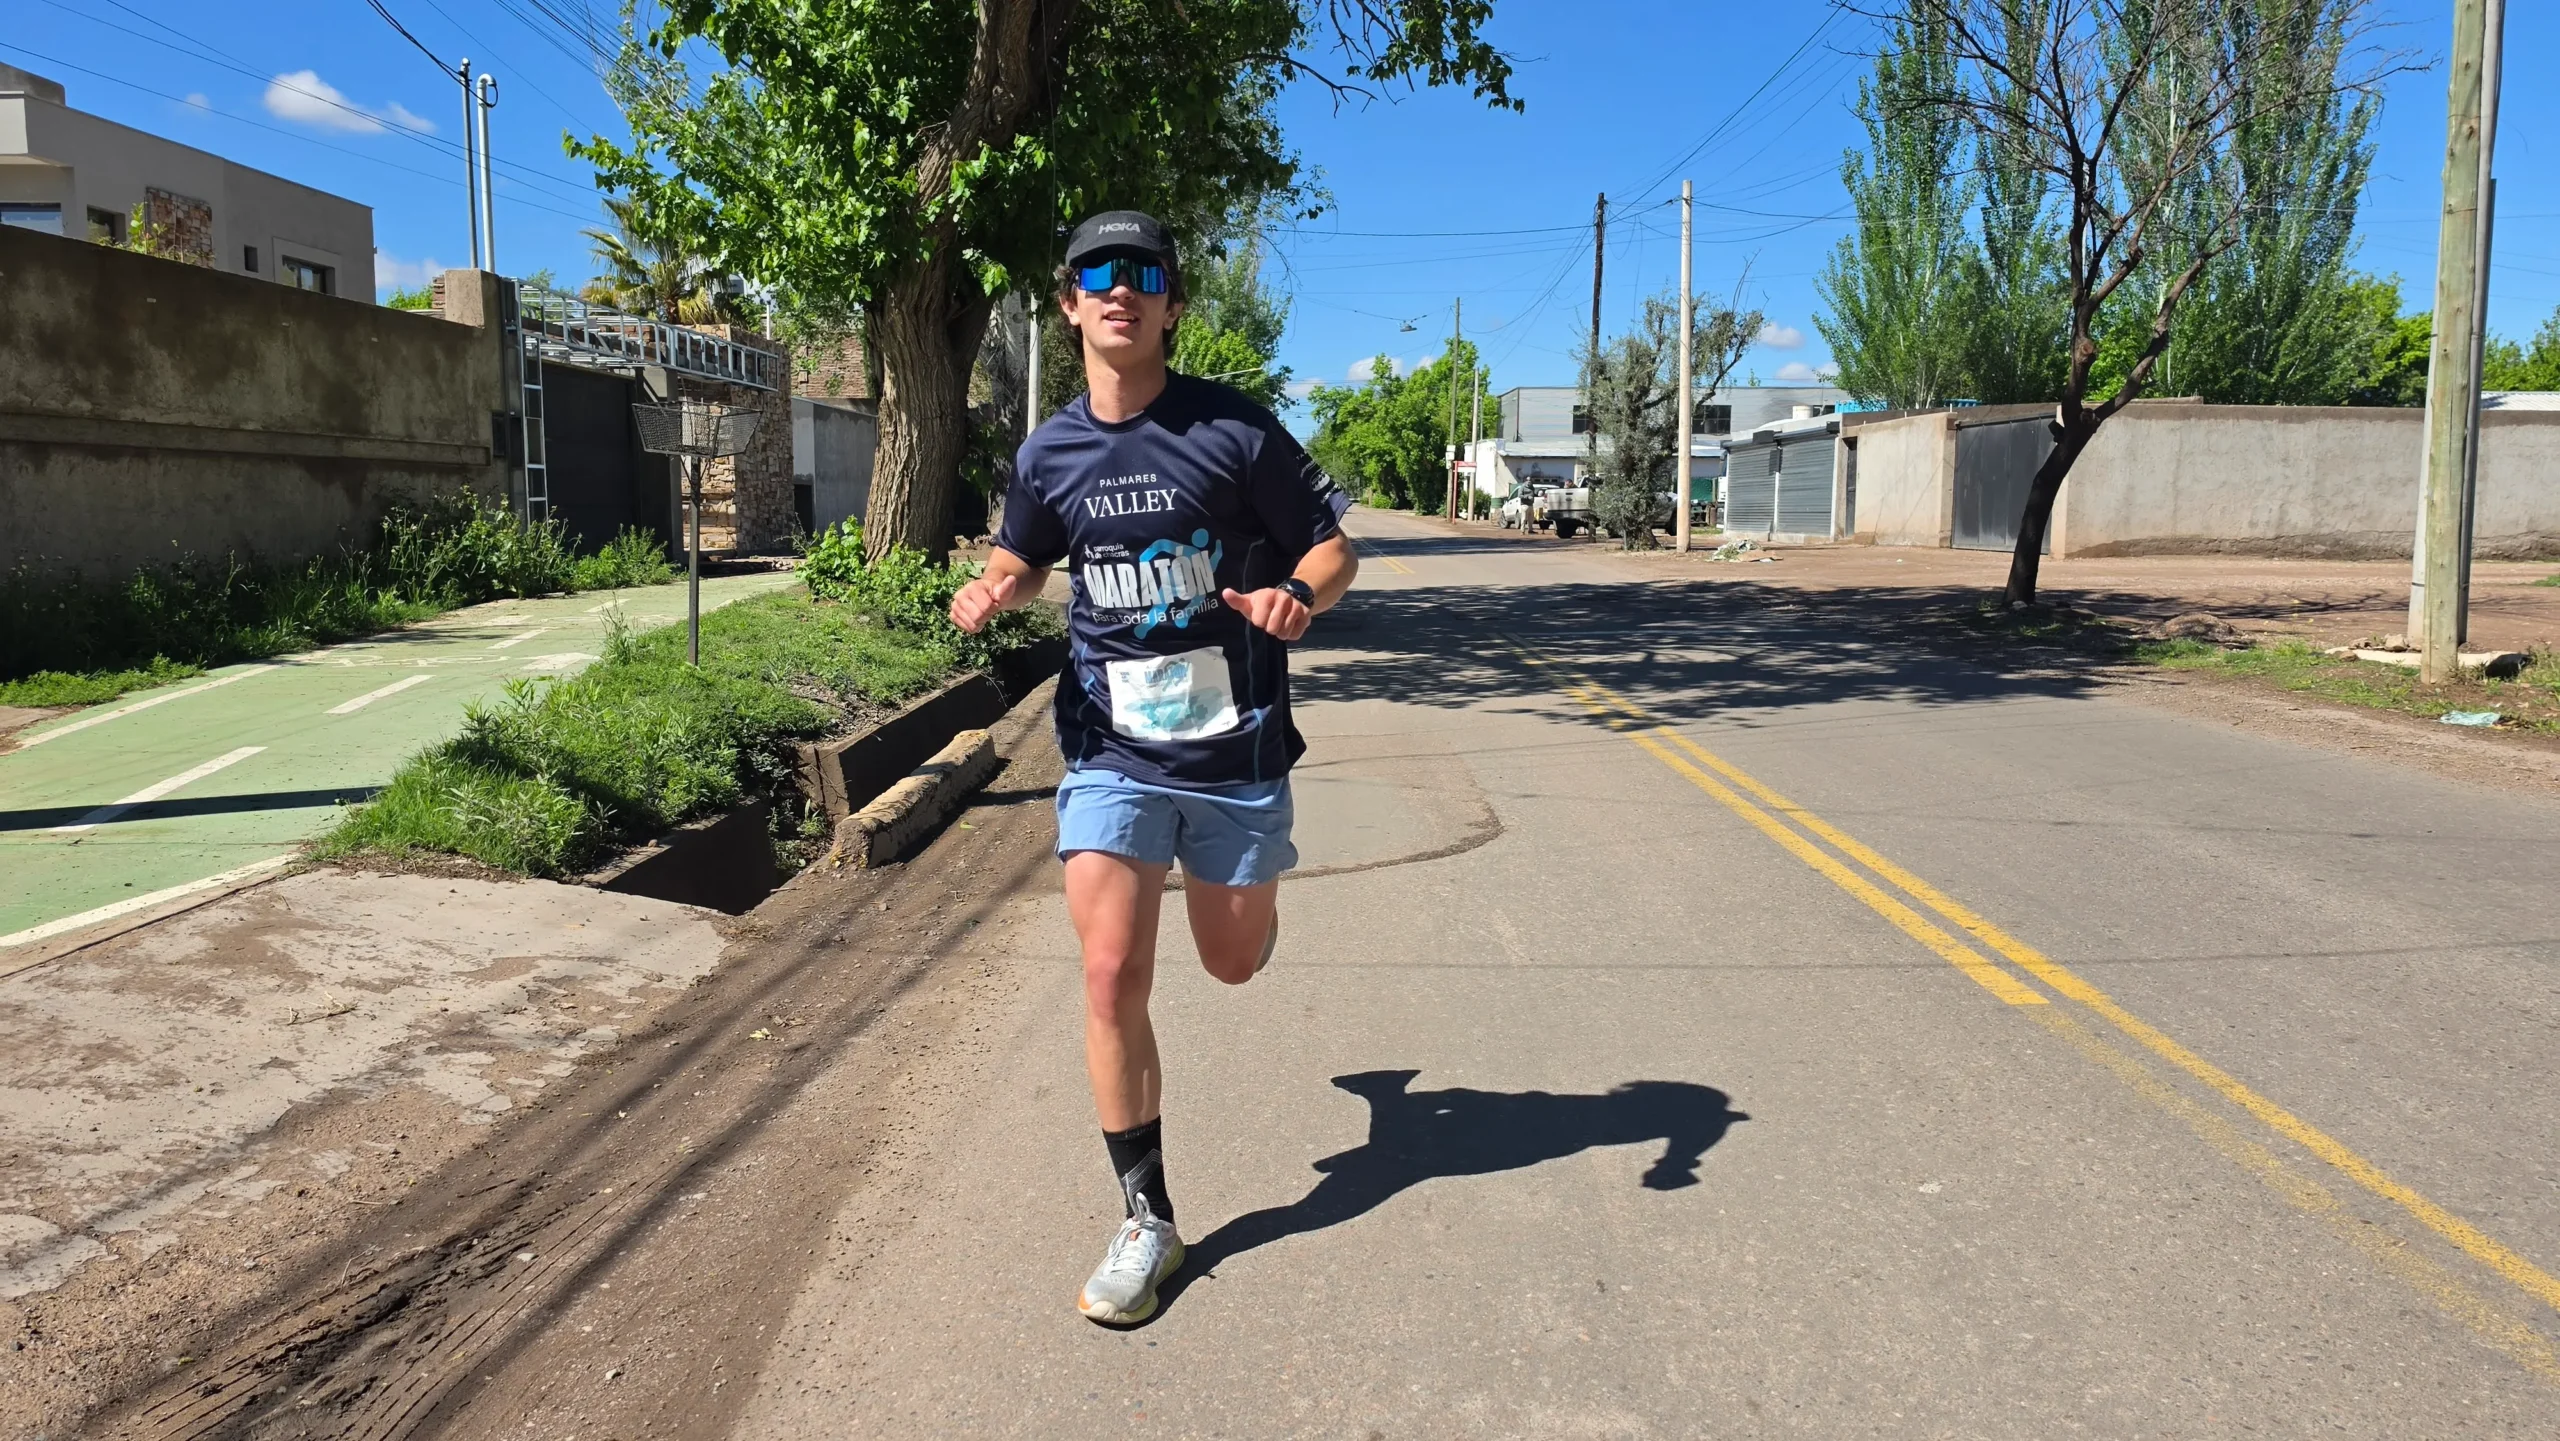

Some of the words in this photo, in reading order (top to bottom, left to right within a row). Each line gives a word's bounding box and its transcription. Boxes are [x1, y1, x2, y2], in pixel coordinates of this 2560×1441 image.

[1098, 222, 1141, 235] HOKA
[1100, 473, 1157, 488] PALMARES
[1084, 488, 1178, 519] VALLEY
[1093, 542, 1125, 553] parroquia
[1084, 545, 1216, 609] MARATÓN
[1092, 611, 1118, 623] para
[1118, 611, 1150, 625] toda
[1154, 608, 1167, 623] la
[1170, 597, 1219, 621] familia
